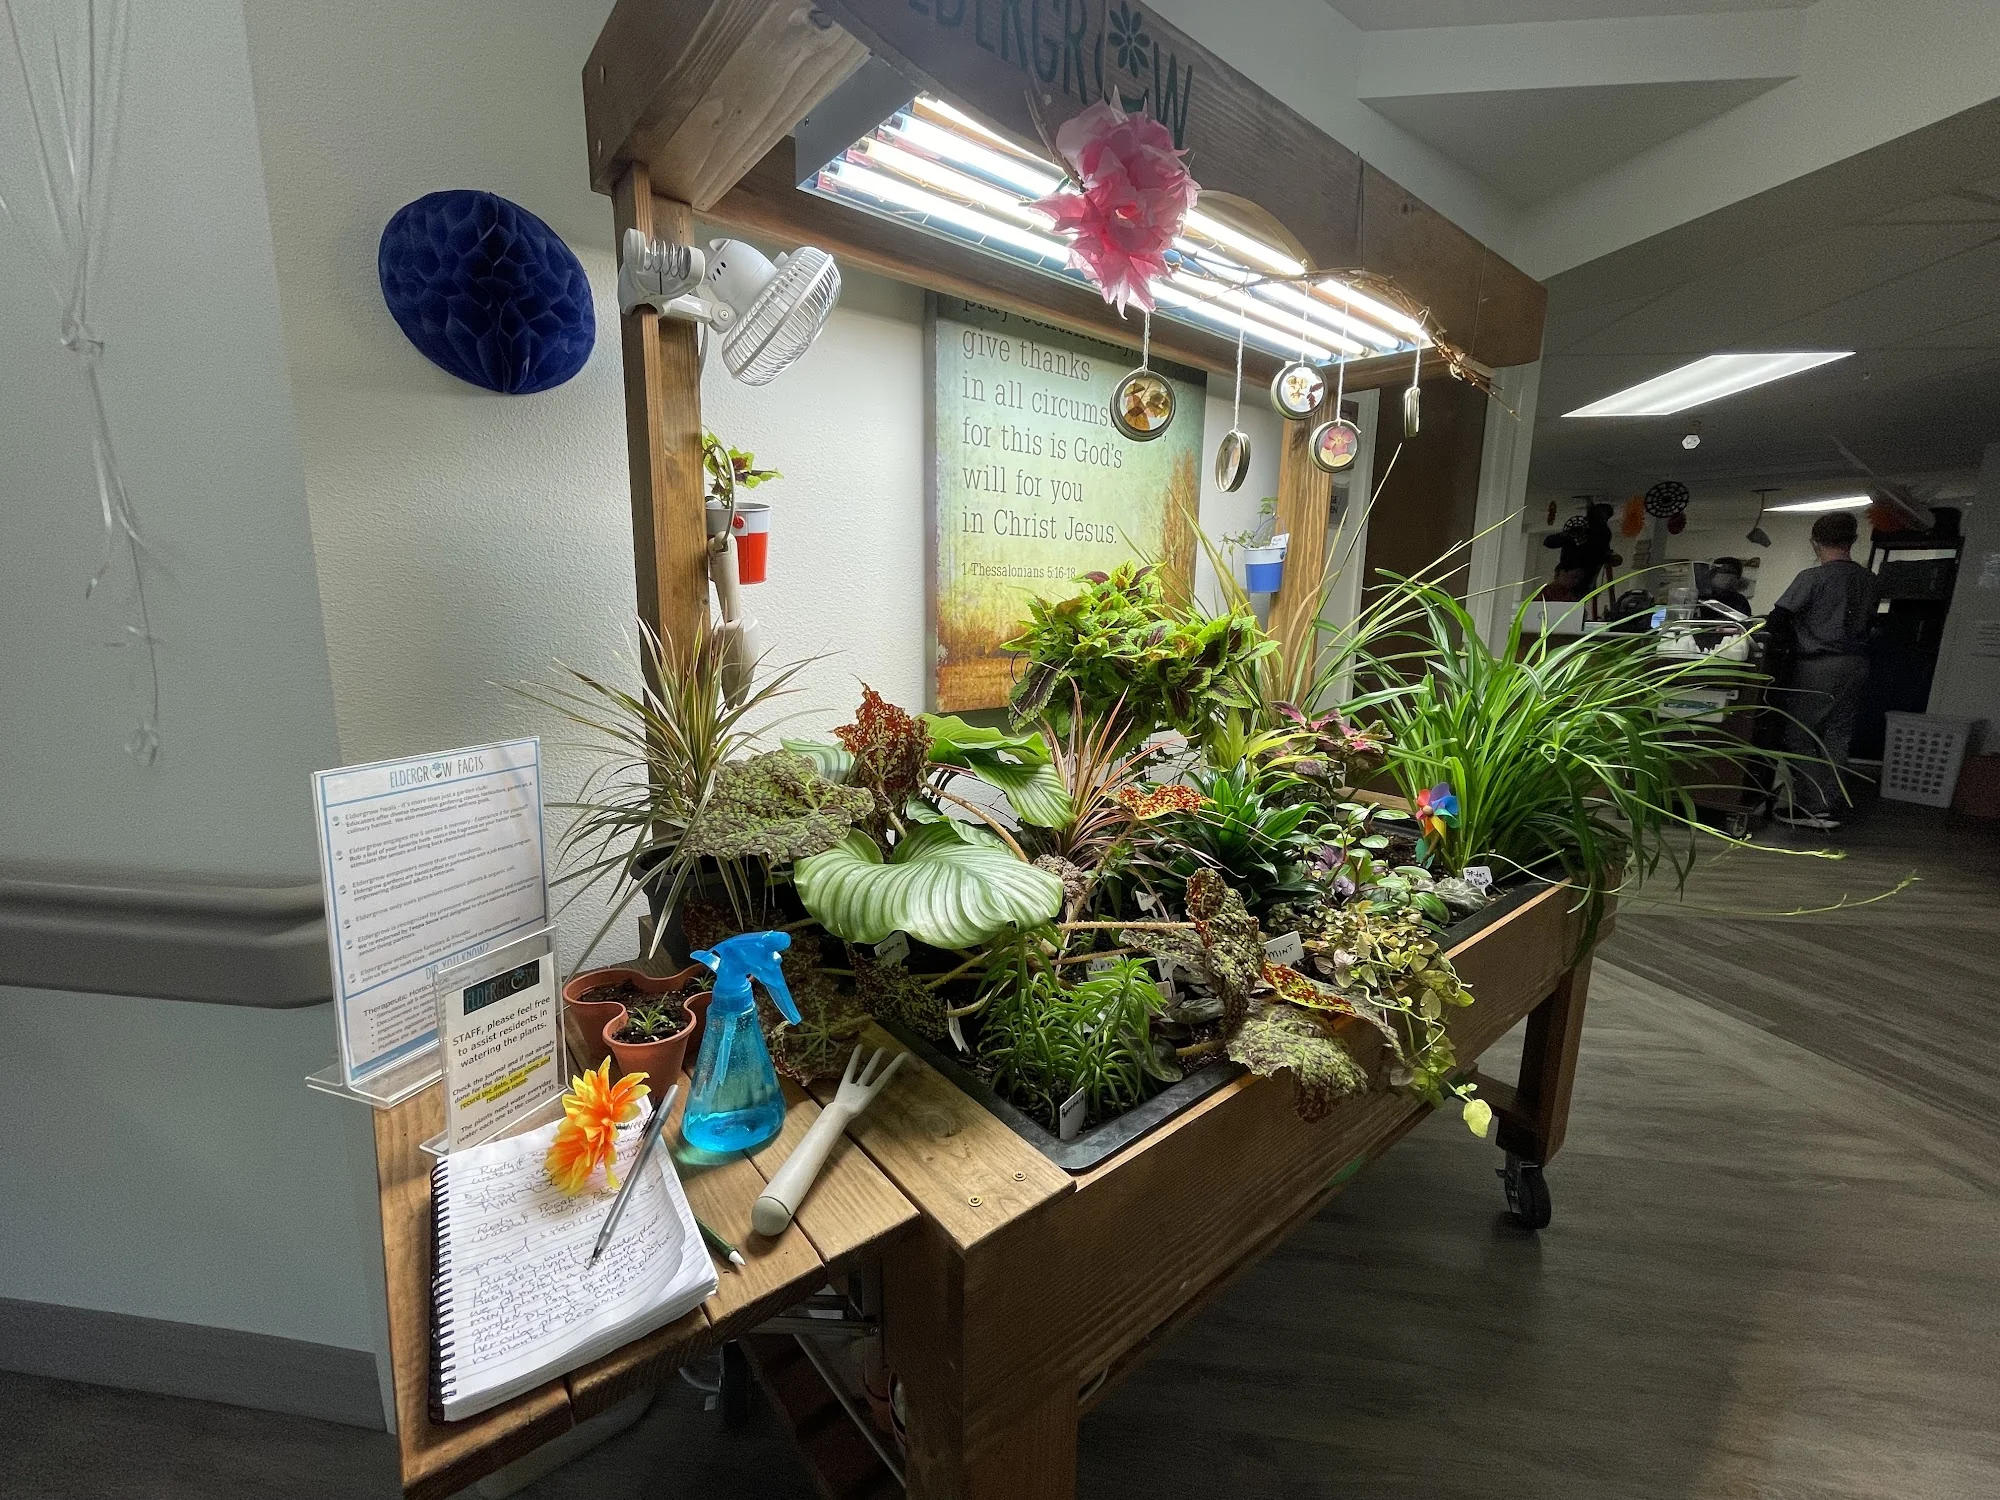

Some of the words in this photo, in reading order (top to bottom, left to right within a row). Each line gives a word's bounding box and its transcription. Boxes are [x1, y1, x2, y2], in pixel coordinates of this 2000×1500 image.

[962, 328, 1011, 363] give
[1020, 341, 1091, 382] thanks
[962, 371, 986, 402] in
[995, 381, 1024, 411] all
[962, 417, 992, 448] for
[1001, 425, 1043, 456] this
[1050, 433, 1067, 461] is
[1074, 437, 1123, 470] God's
[962, 465, 1008, 495] will
[1016, 469, 1043, 498] for
[1051, 477, 1084, 506] you
[962, 506, 986, 534] in
[994, 509, 1058, 541] Christ
[1064, 516, 1118, 545] Jesus.
[961, 562, 968, 577] 1
[970, 562, 1046, 579] Thessalonians
[458, 755, 484, 775] FACTS
[364, 994, 407, 1017] Therapeutic
[453, 1026, 484, 1046] STAFF,
[488, 1013, 515, 1032] please
[517, 1003, 532, 1017] feel
[535, 996, 550, 1009] free
[461, 1044, 500, 1067] watering
[504, 1036, 517, 1047] the
[520, 1023, 546, 1040] plants.
[471, 1031, 496, 1051] assist
[500, 1014, 537, 1037] residents
[453, 1082, 471, 1097] Check
[473, 1077, 483, 1086] the
[485, 1064, 505, 1081] journal
[508, 1058, 518, 1068] and
[525, 1050, 534, 1059] not
[536, 1041, 554, 1053] already
[462, 1124, 472, 1133] The
[475, 1112, 492, 1127] plants
[495, 1102, 508, 1115] need
[511, 1094, 526, 1106] water
[528, 1080, 551, 1095] everyday
